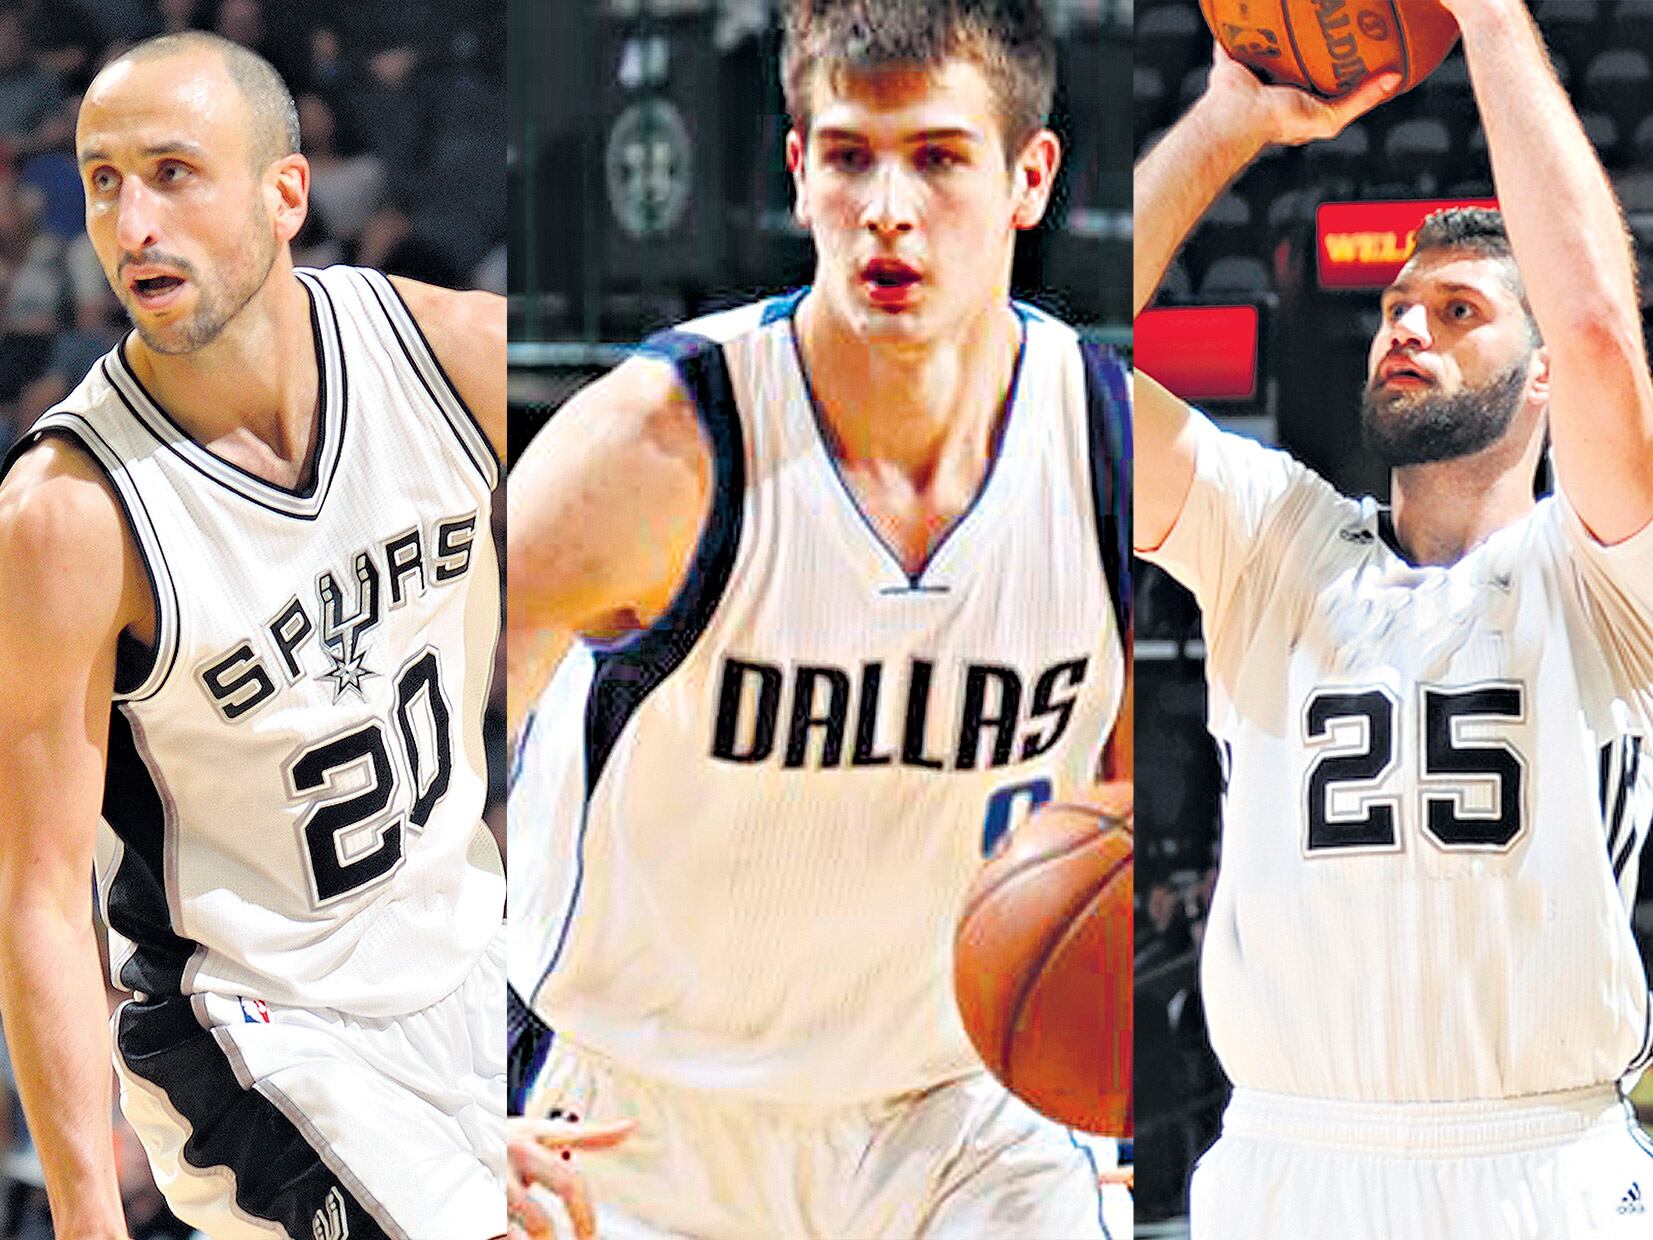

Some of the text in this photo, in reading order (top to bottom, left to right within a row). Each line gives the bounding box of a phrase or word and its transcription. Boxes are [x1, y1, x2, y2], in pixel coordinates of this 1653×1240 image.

[197, 510, 477, 722] SPURS
[711, 657, 1089, 769] DALLAS
[285, 644, 453, 909] 20
[1304, 681, 1526, 857] 25
